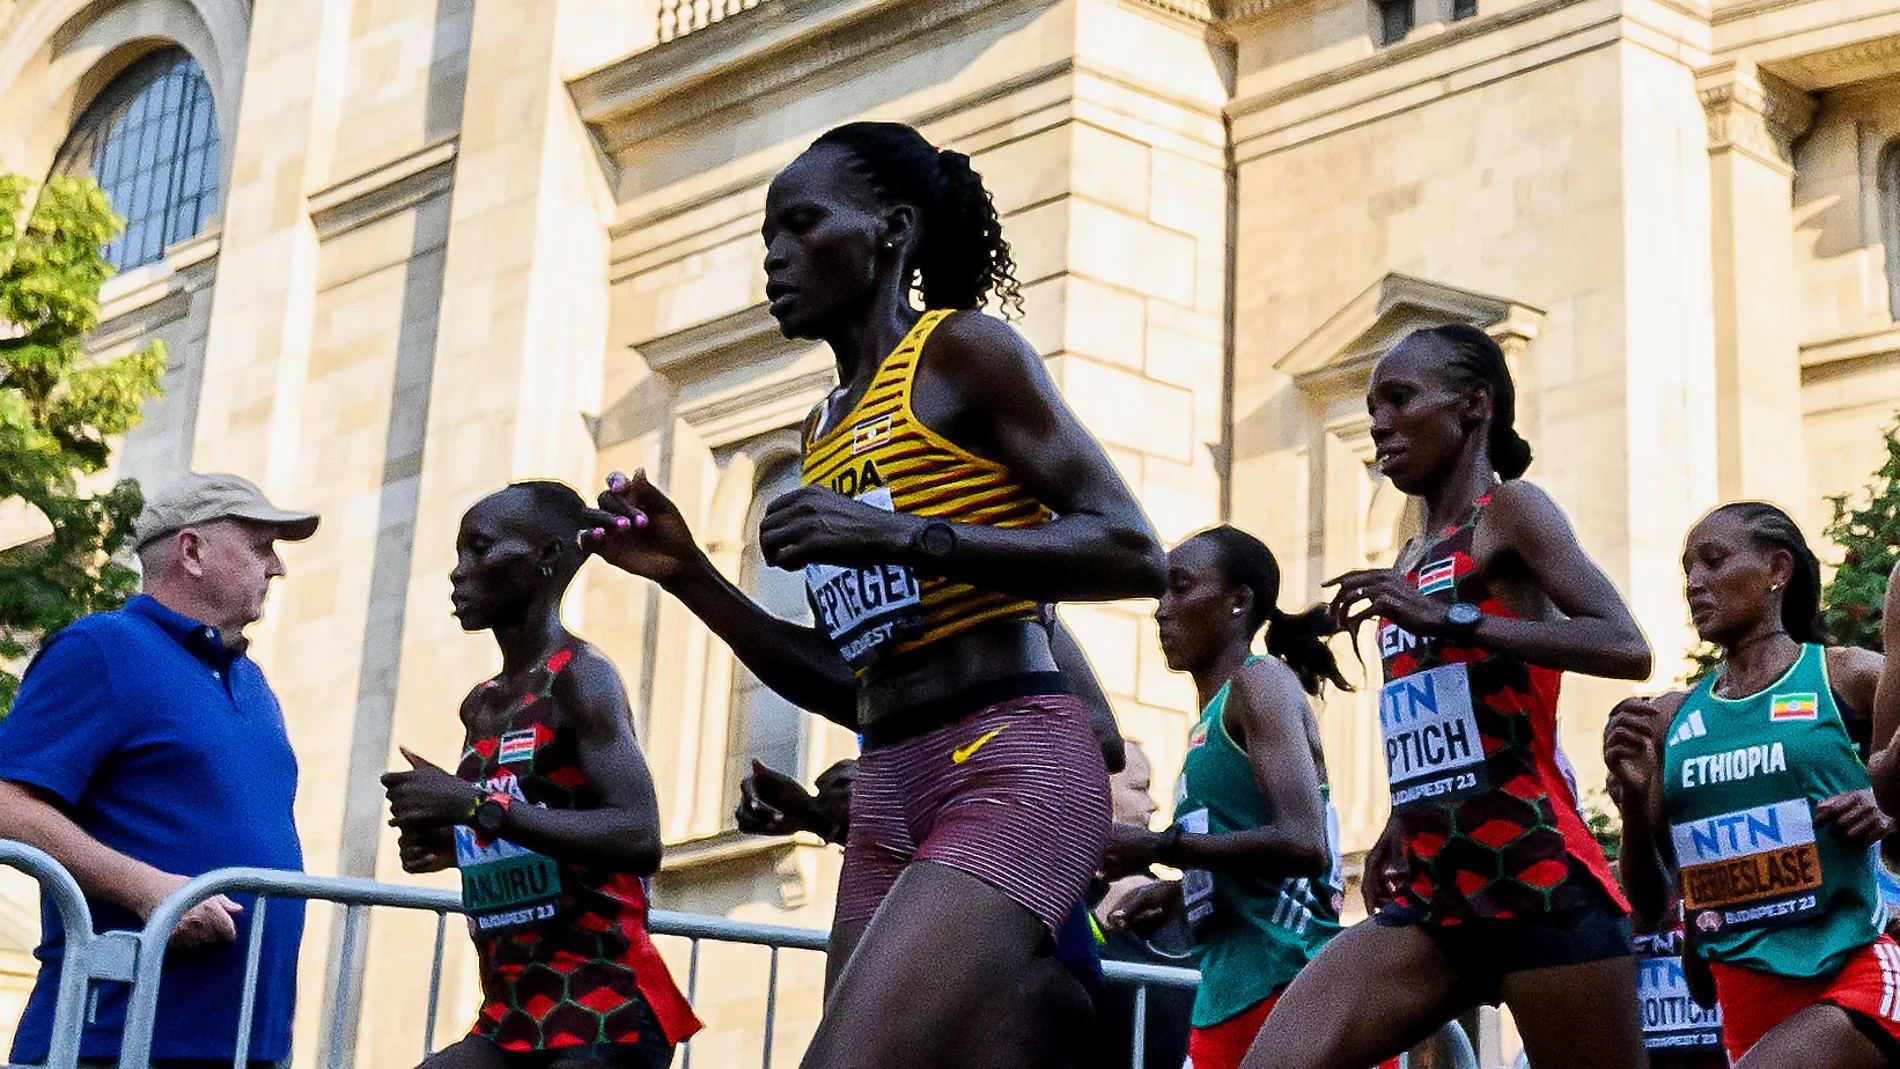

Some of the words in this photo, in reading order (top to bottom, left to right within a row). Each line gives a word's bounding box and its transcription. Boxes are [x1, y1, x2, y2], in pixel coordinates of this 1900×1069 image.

[1386, 718, 1471, 777] PTICH
[1682, 742, 1787, 789] ETHIOPIA
[1454, 772, 1477, 790] 23
[1690, 807, 1783, 859] NTN
[1798, 894, 1817, 911] 23
